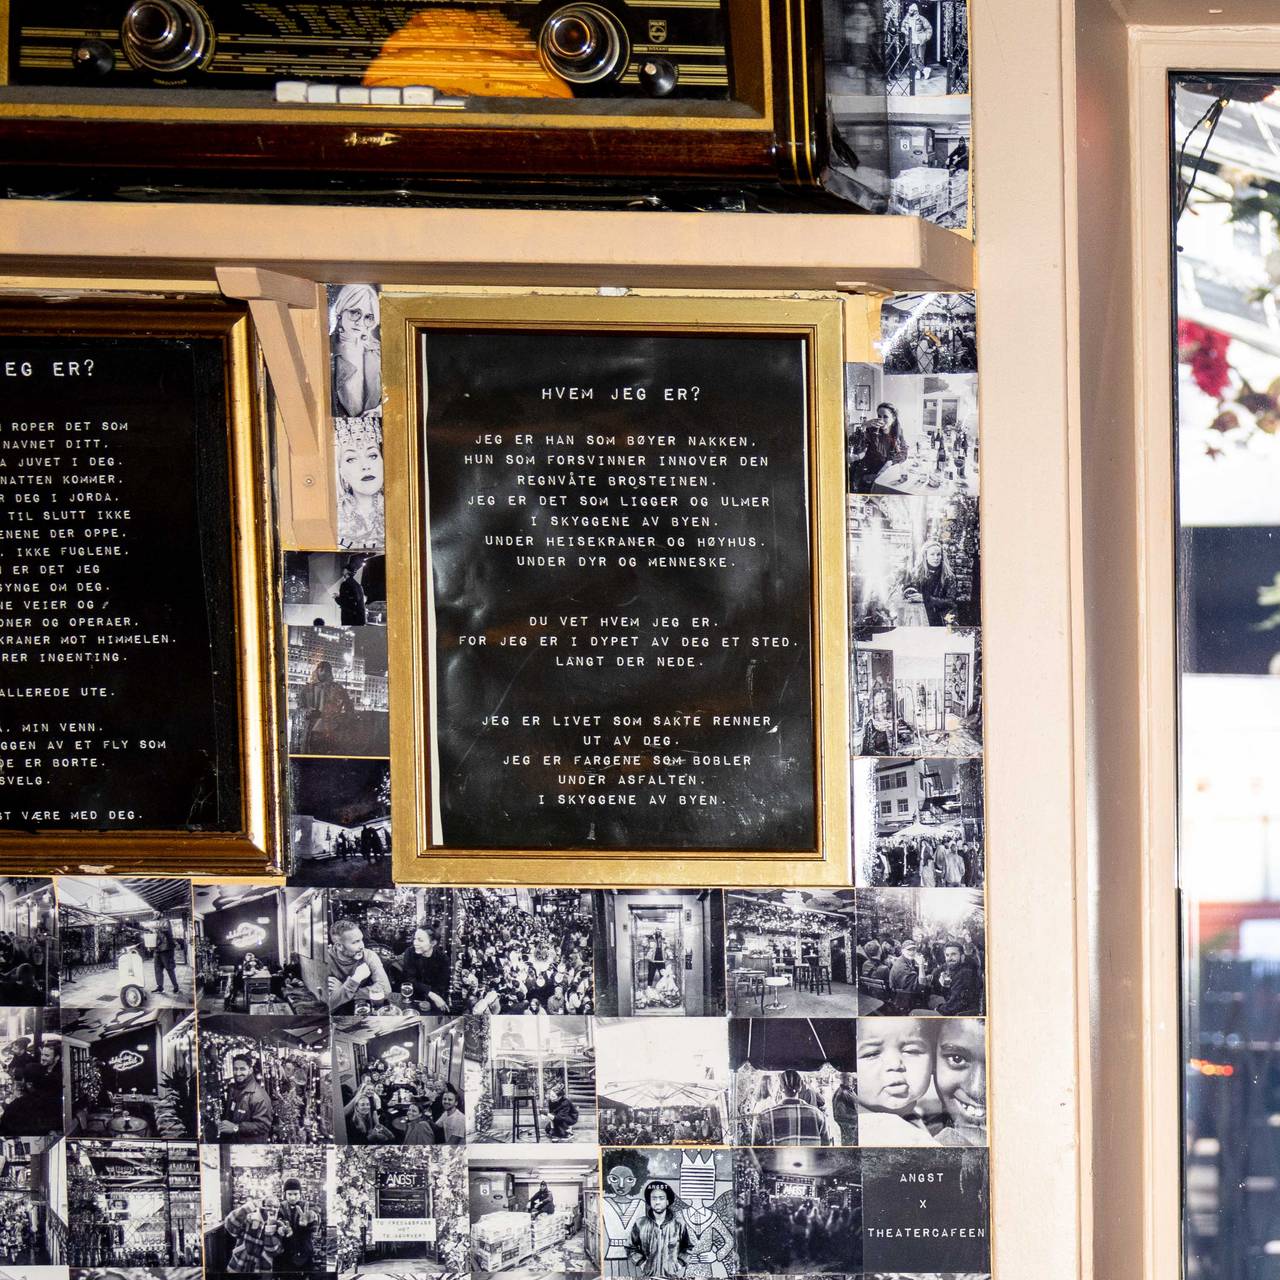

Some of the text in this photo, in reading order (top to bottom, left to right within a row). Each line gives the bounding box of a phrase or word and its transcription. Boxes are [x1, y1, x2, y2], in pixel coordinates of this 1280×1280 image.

[52, 358, 95, 377] ER?
[541, 385, 701, 402] HVEM JEG ER?
[2, 439, 56, 450] NAVNET
[475, 433, 503, 445] JEG
[514, 434, 534, 445] ER
[545, 434, 575, 446] HAN
[586, 434, 616, 446] SOM
[626, 434, 676, 447] BØYER
[464, 453, 769, 467] HUN SOM FORSVINNER INNOVER DEN
[516, 471, 597, 487] REGNVÅTE
[7, 509, 131, 522] TIL SLUTT IKKE
[484, 535, 534, 547] UNDER
[546, 535, 656, 548] HEISEKRANER
[666, 536, 686, 548] OG
[516, 555, 566, 567] UNDER
[578, 556, 607, 567] DYR
[618, 556, 637, 568] OG
[60, 634, 87, 645] MOT
[555, 655, 605, 667] LANGT
[616, 656, 645, 667] DER
[481, 715, 772, 727] JEG ER LIVET SOM SAKTE RENNER
[21, 810, 61, 821] VÆRE
[70, 810, 98, 821] MED
[385, 1173, 418, 1186] ANGST
[899, 1172, 944, 1183] ANGST
[919, 1199, 927, 1209] X
[867, 1227, 985, 1238] THEATERCAFEEN
